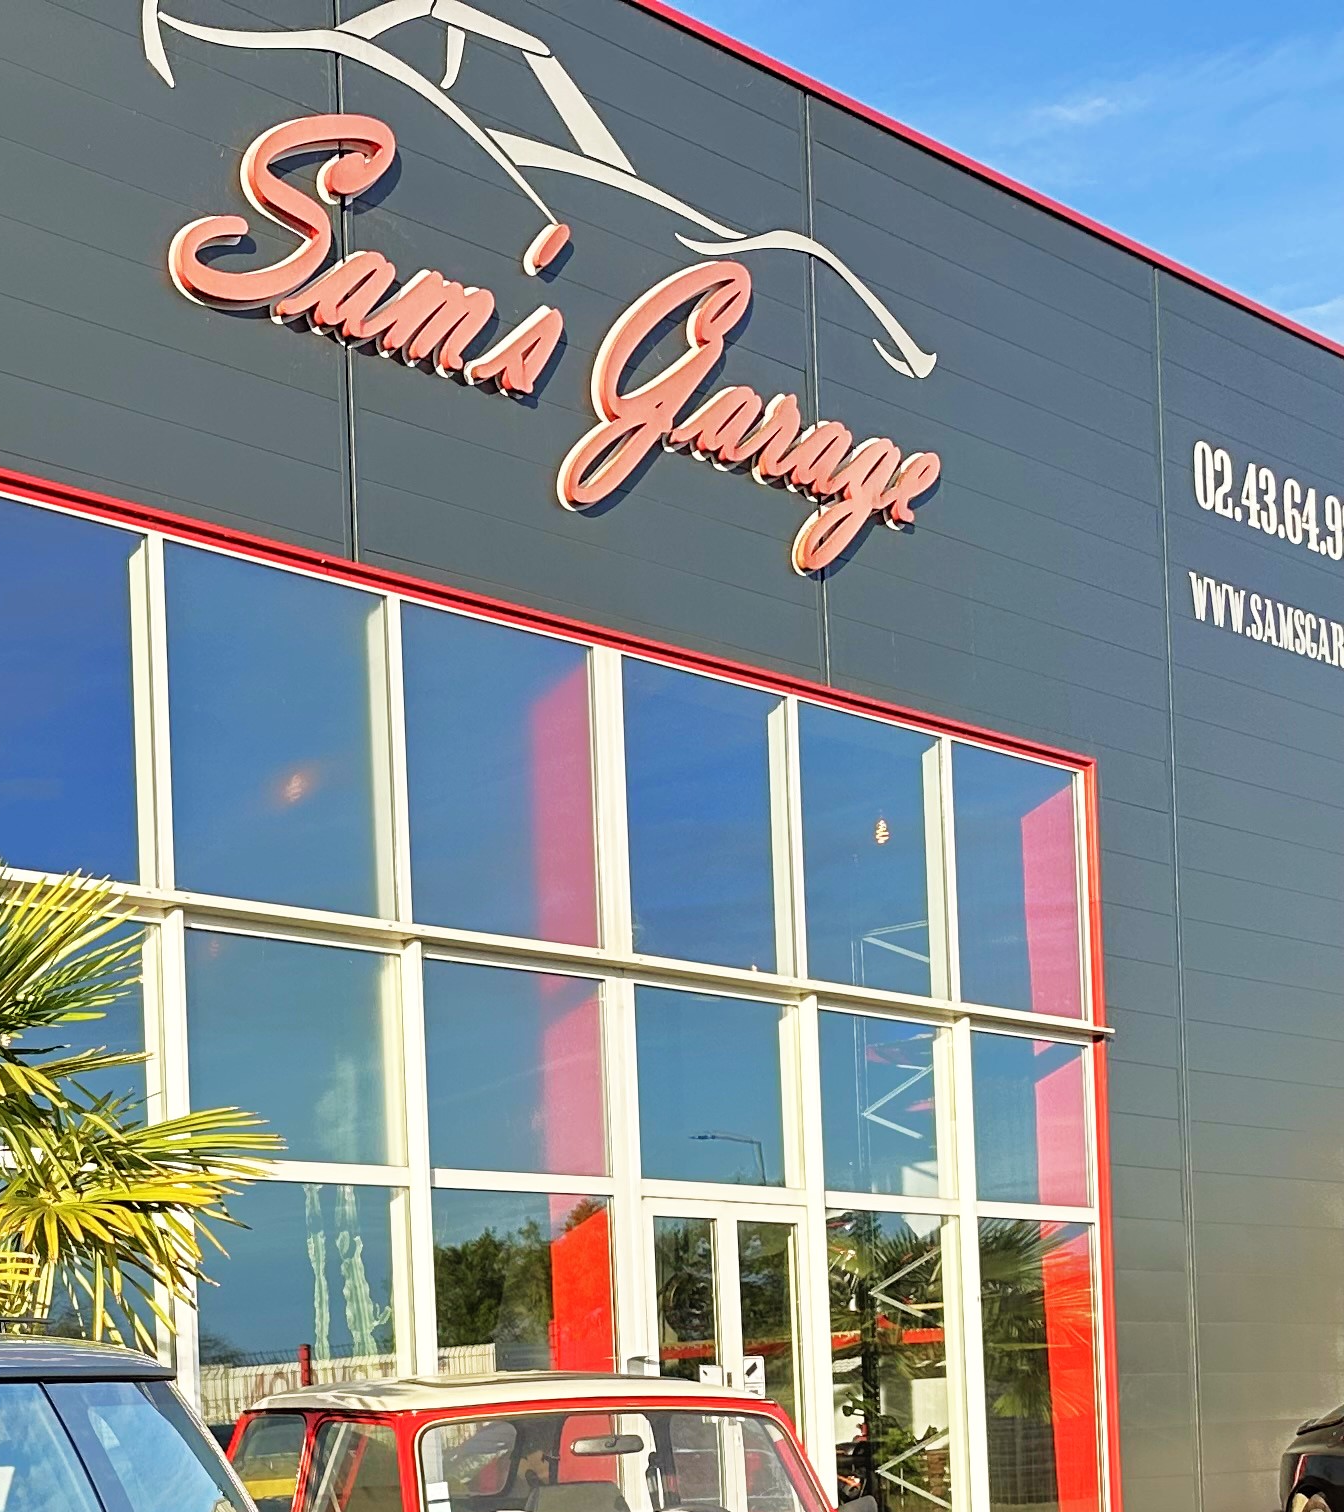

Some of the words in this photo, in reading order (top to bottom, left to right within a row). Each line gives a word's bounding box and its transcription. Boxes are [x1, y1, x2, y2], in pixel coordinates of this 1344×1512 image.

[168, 114, 571, 397] Sam's
[556, 260, 941, 576] Garage
[1193, 440, 1344, 561] 02.43.64.9
